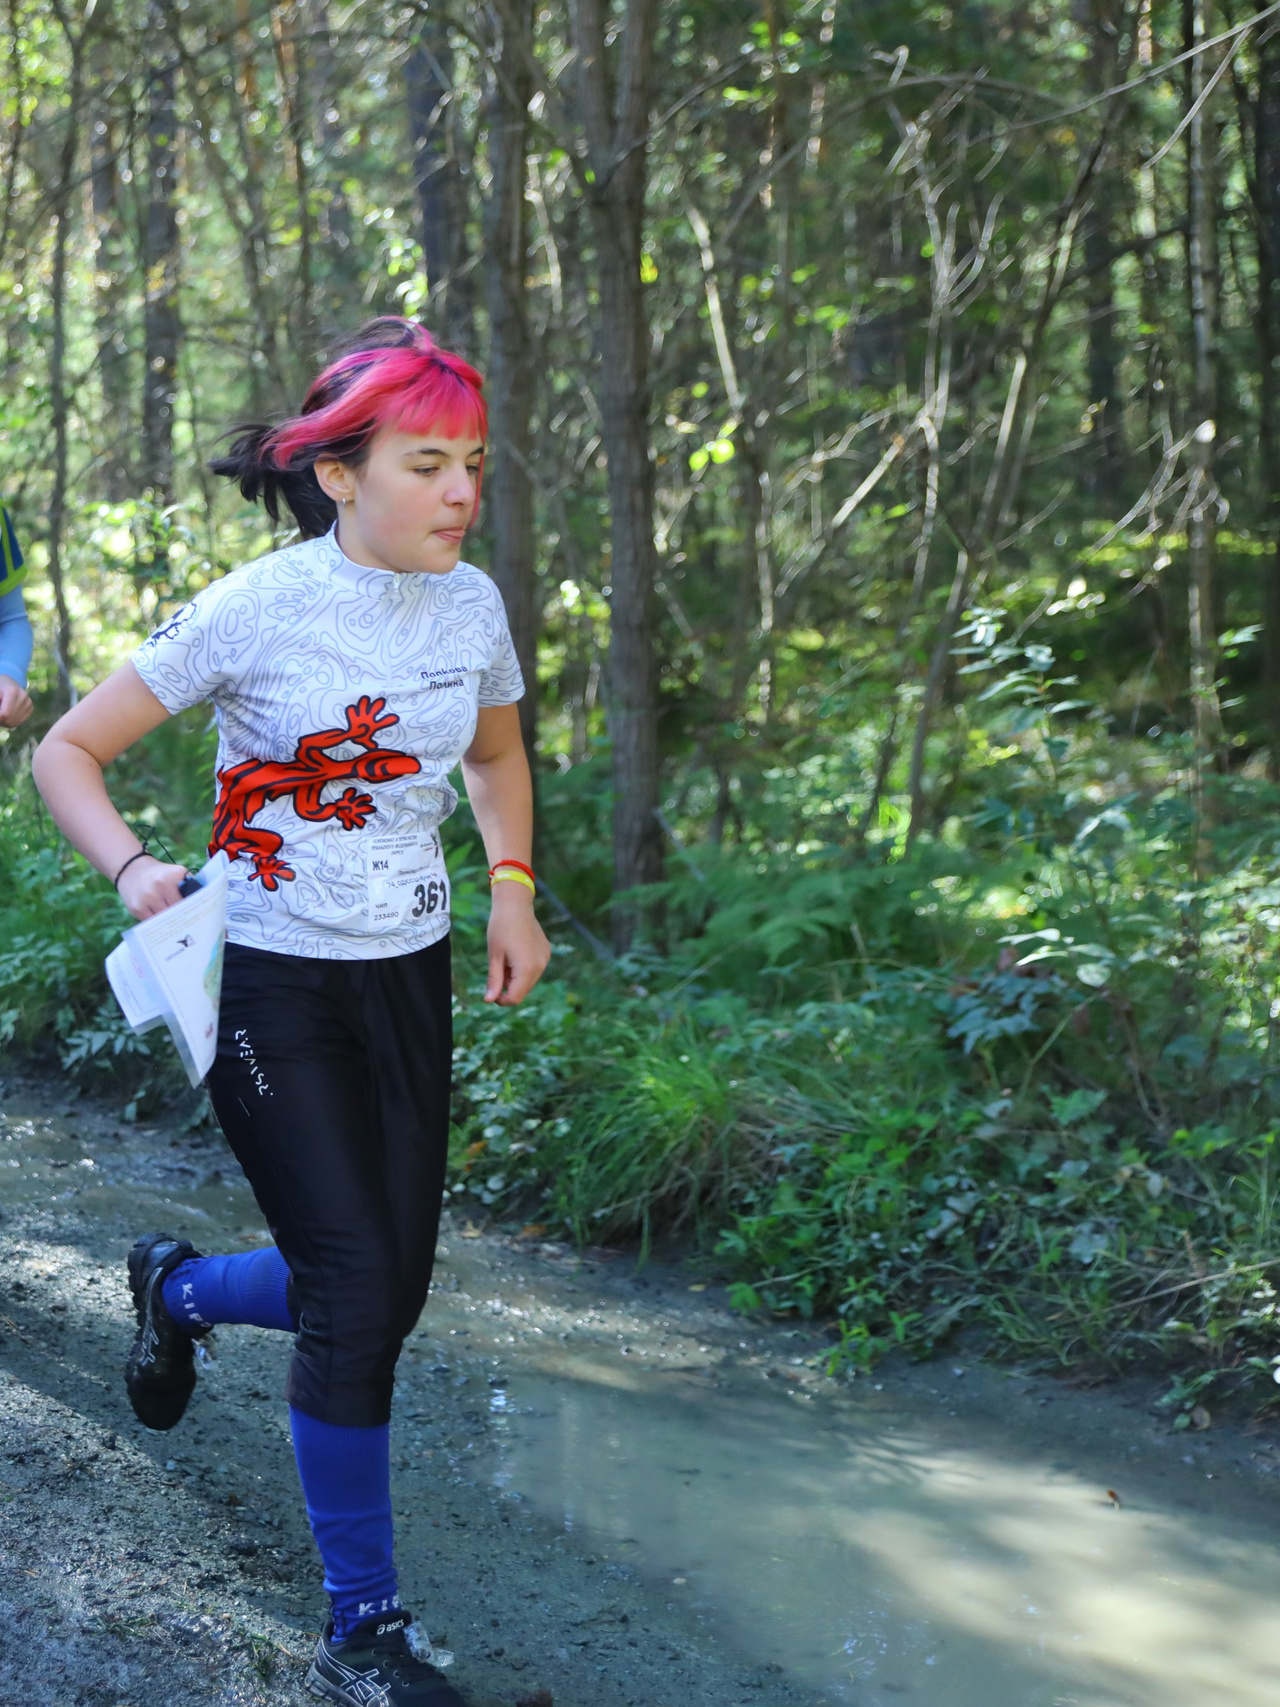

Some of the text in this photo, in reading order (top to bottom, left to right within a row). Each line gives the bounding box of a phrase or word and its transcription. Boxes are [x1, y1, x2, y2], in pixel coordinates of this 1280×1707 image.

[420, 666, 468, 680] Попкова
[429, 679, 464, 690] Полина
[372, 860, 389, 871] Ж14
[412, 879, 447, 918] 361
[386, 1619, 404, 1632] asics
